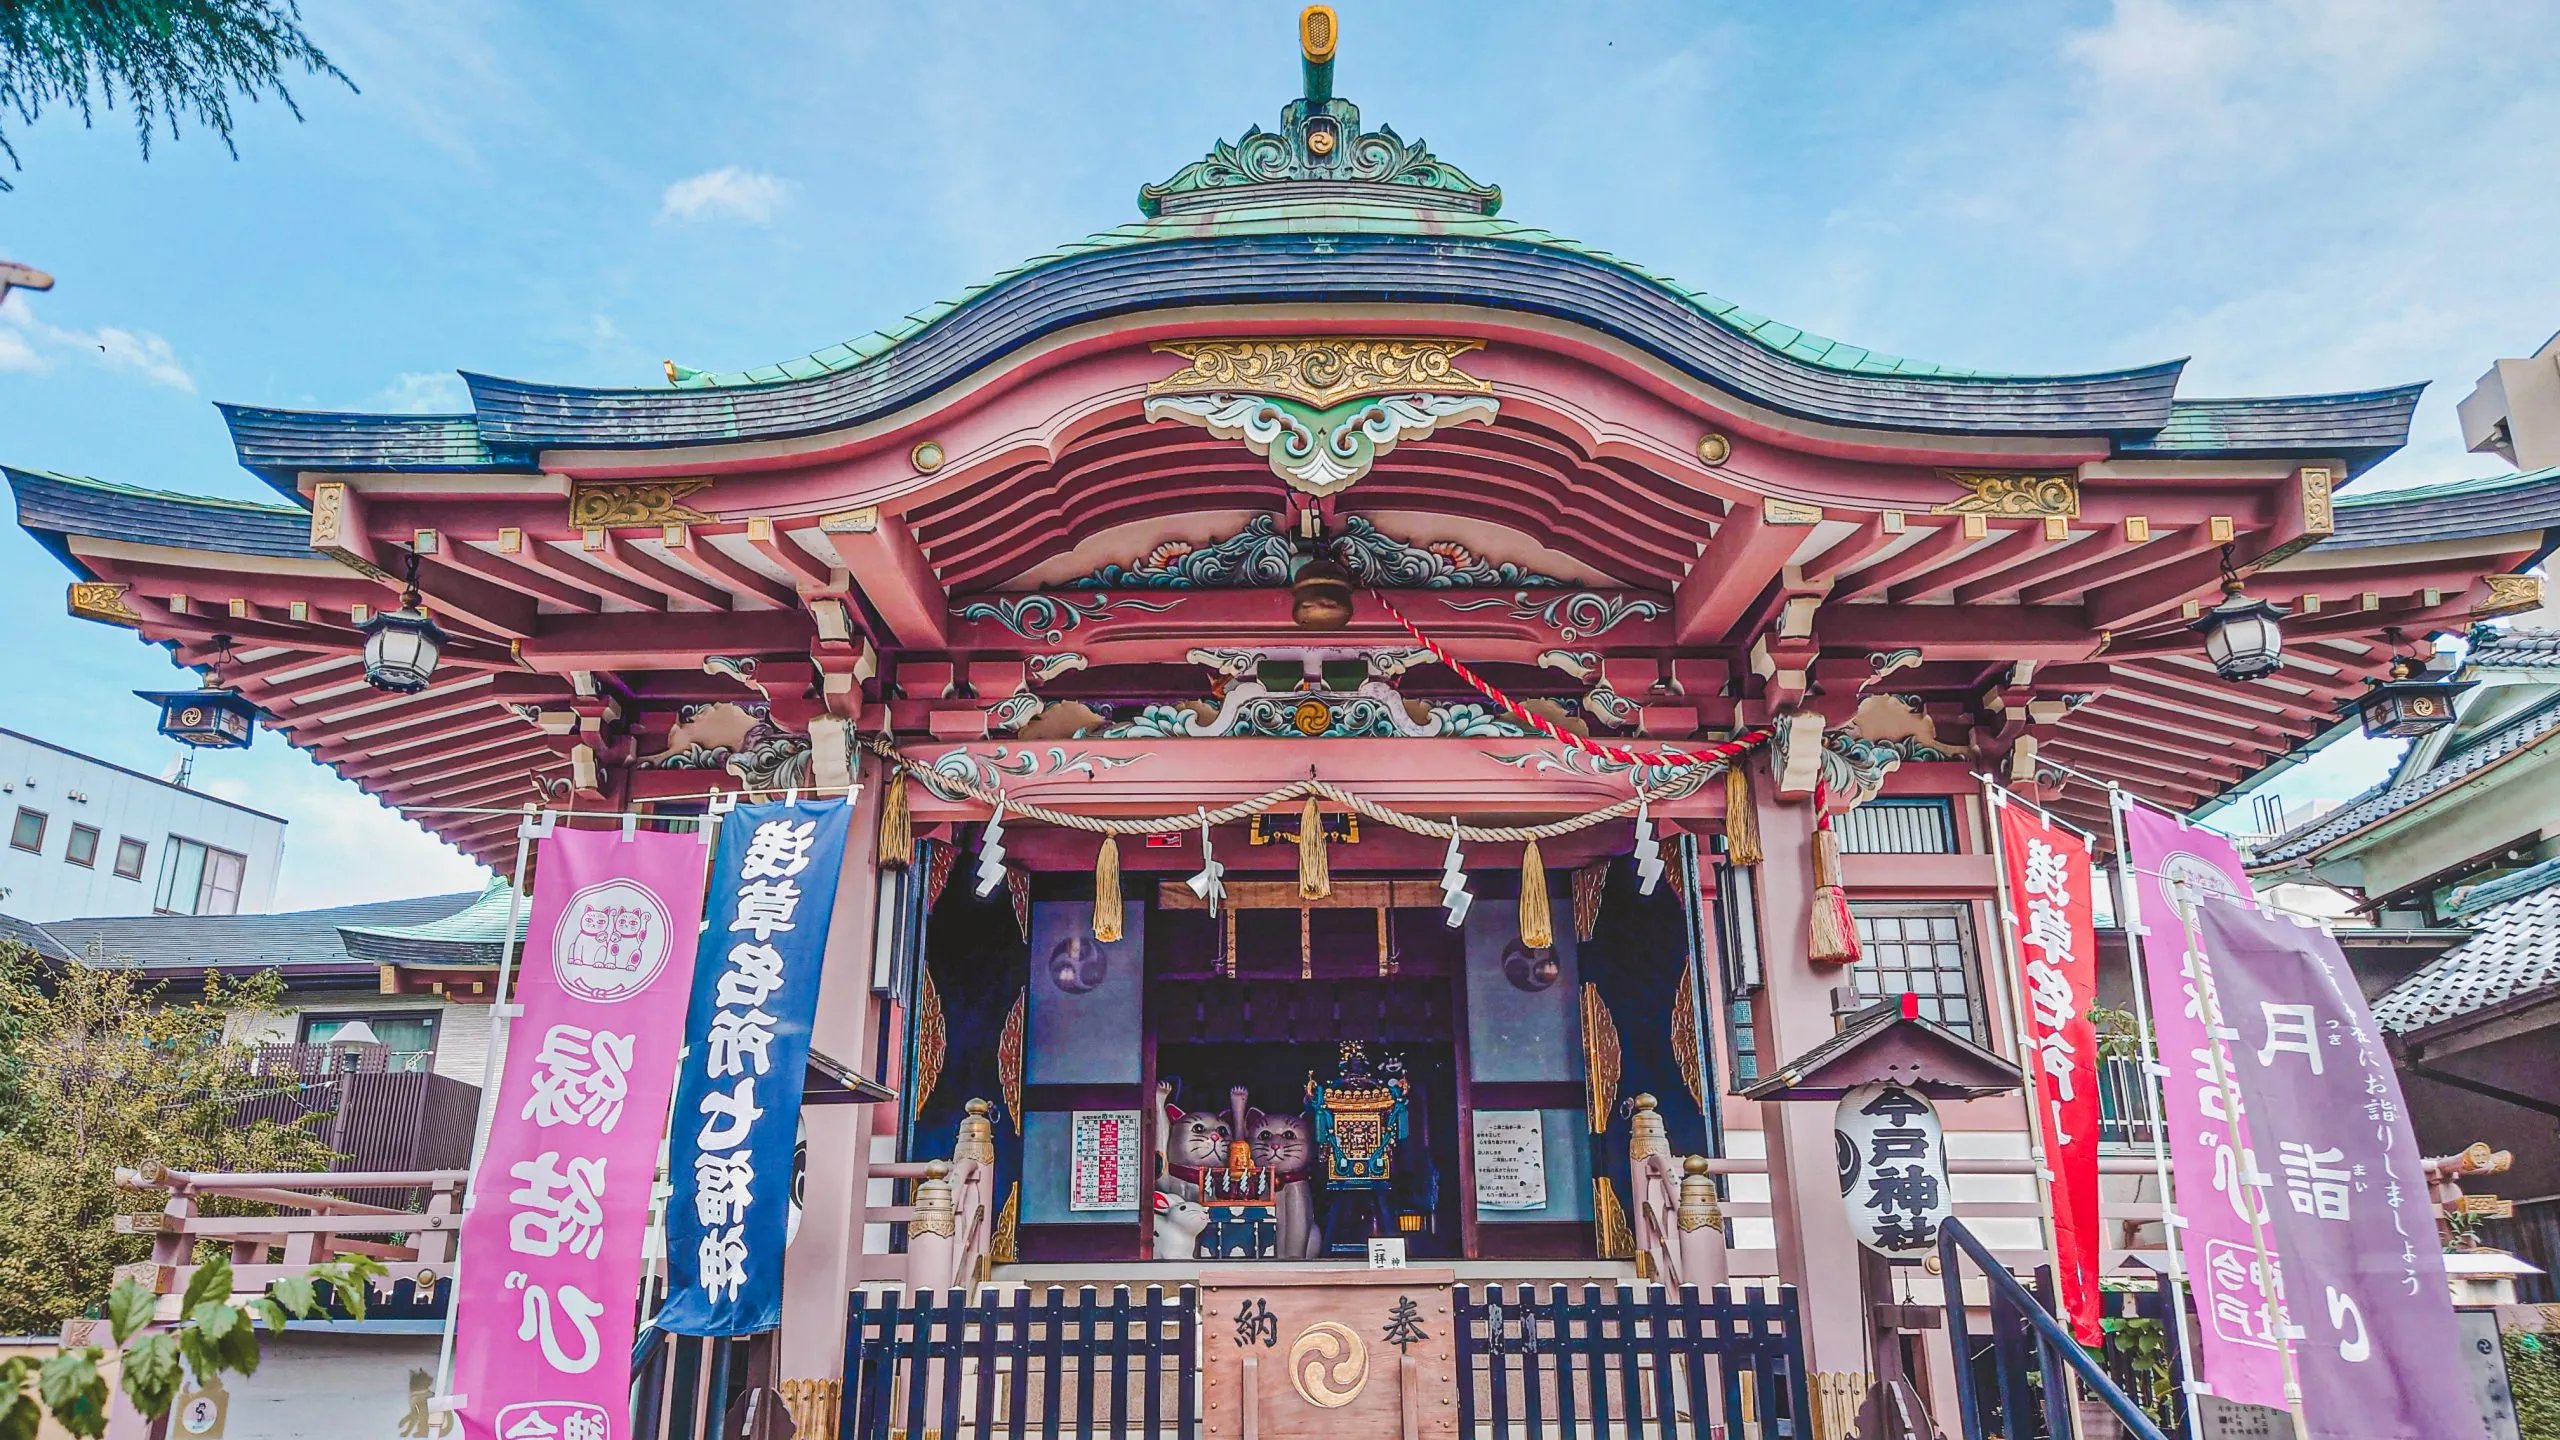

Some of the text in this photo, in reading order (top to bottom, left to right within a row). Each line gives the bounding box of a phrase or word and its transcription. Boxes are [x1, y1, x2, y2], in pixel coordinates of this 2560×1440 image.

[2326, 1019, 2342, 1046] つき
[1859, 1086, 1939, 1252] 今戸神社
[2257, 1001, 2370, 1362] 月詣り
[2352, 1164, 2368, 1193] まい
[1234, 1295, 1430, 1354] 奉 納
